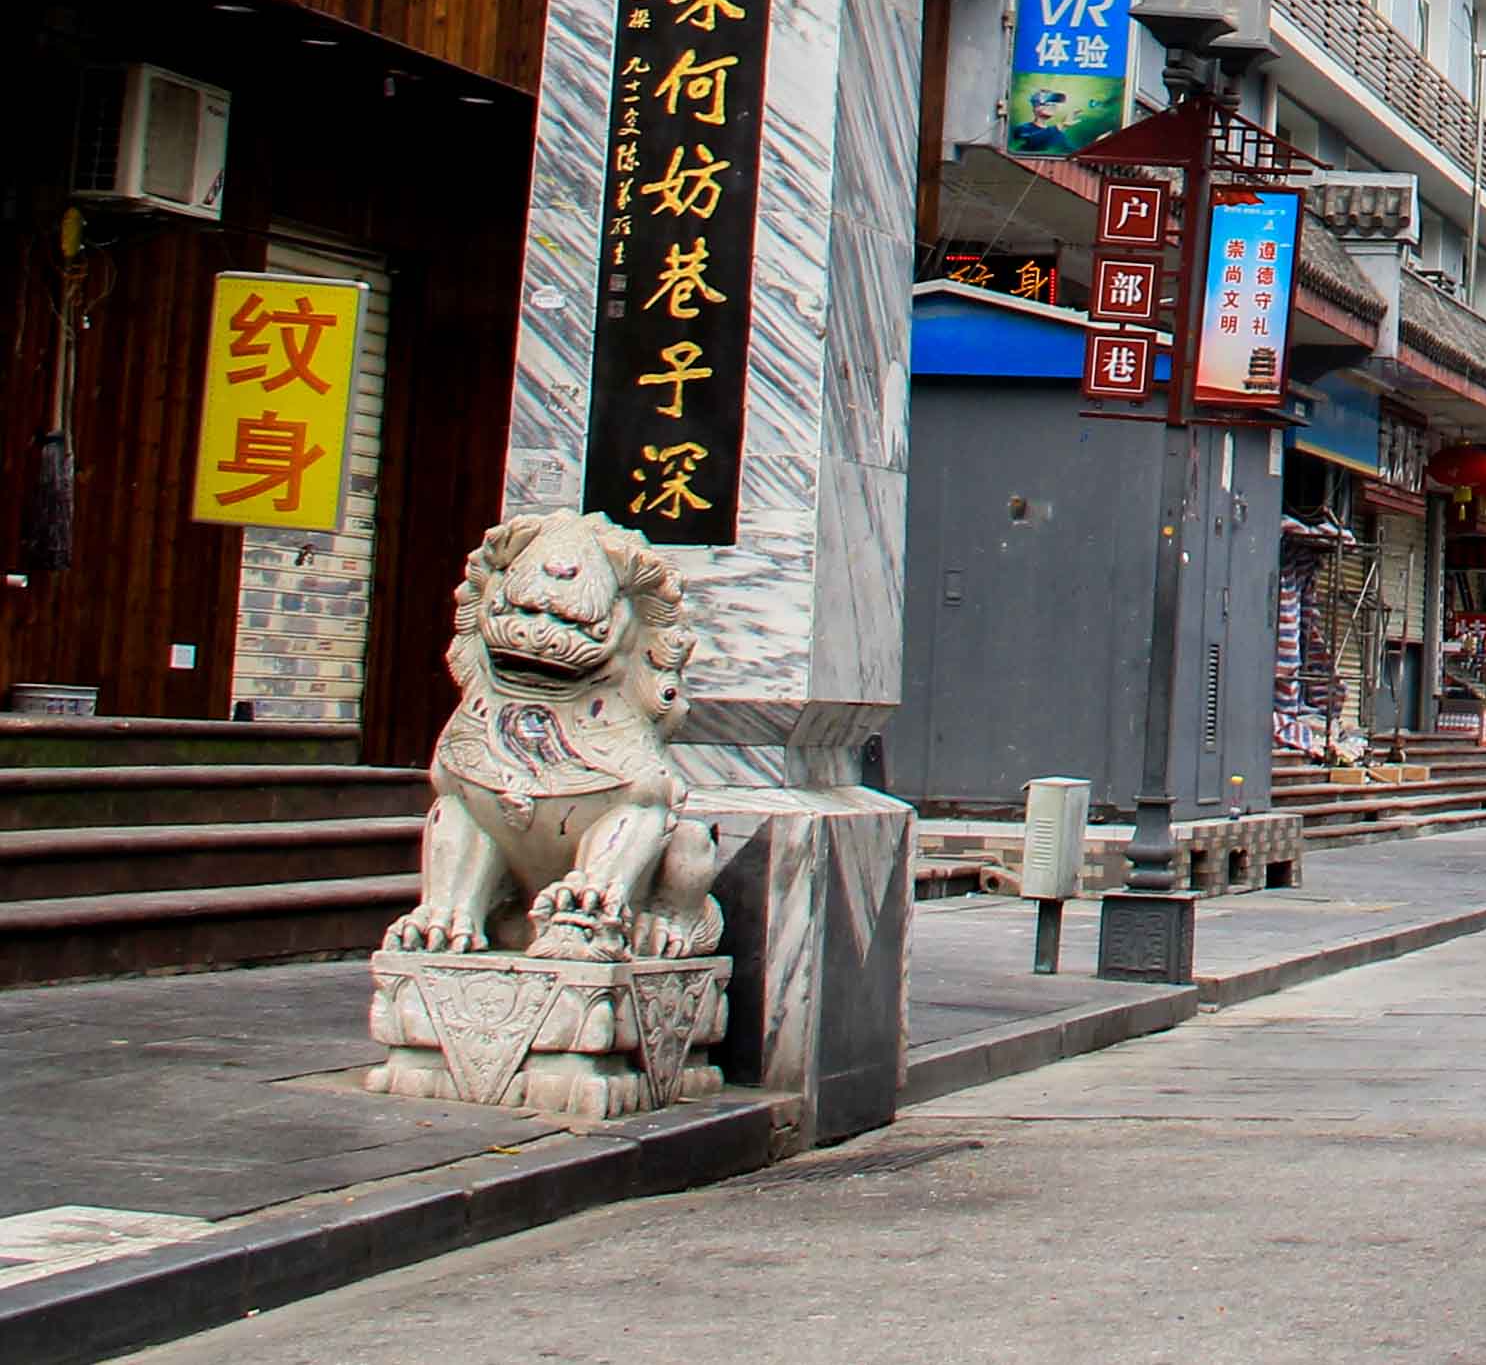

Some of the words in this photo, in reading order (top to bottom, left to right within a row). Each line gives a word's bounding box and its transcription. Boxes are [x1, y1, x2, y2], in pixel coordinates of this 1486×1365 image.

[1035, 33, 1110, 70] 体验
[1101, 196, 1152, 384] 户部巷
[1220, 239, 1246, 335] 崇尚文明
[1252, 241, 1277, 336] 遵德守礼
[214, 292, 338, 513] 纹身
